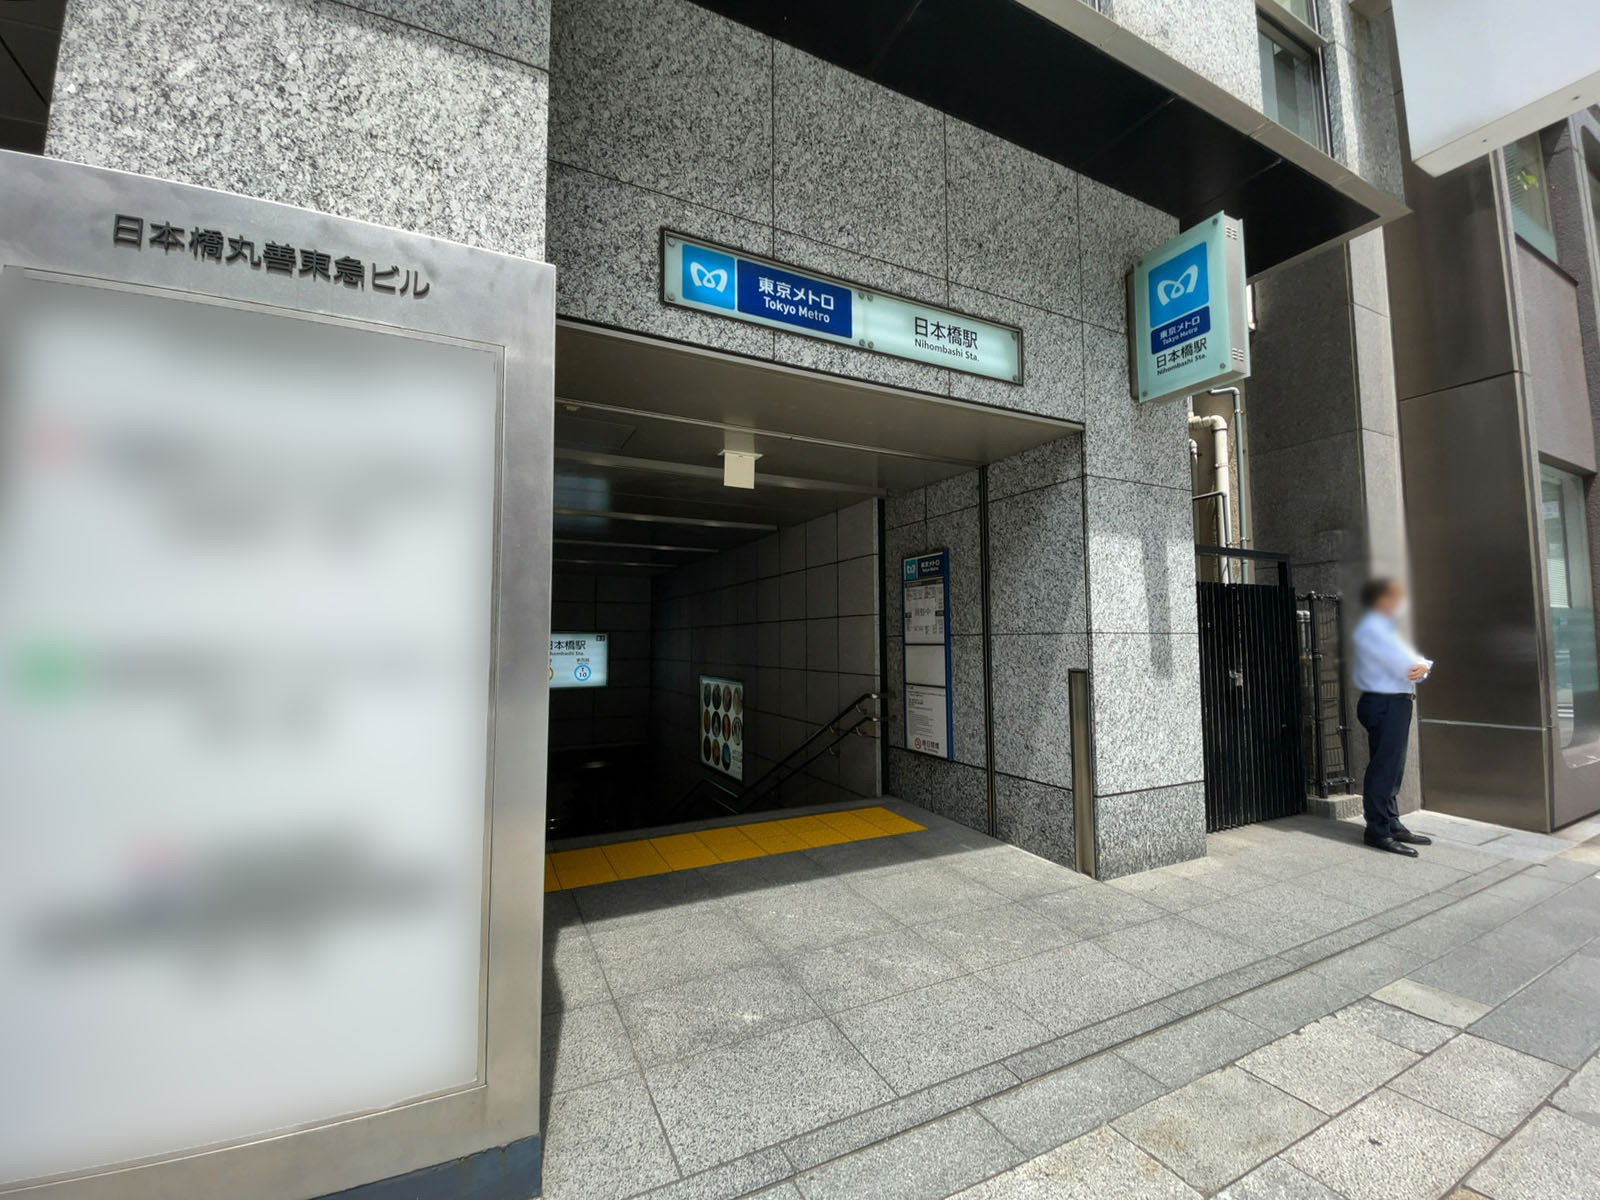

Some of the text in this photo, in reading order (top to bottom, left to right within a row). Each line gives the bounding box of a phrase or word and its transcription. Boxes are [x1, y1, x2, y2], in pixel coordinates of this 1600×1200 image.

[112, 213, 430, 298] 日本橋丸善東急ビル
[758, 276, 834, 310] 東京メトロ
[763, 296, 831, 323] Tokyo Metro
[915, 316, 978, 350] 日本橋駅
[1160, 316, 1200, 339] 東京メトロ
[1162, 334, 1179, 345] Tokyo
[914, 338, 980, 362] Nihombashi Sta.
[1156, 337, 1207, 368] 日本橋駅
